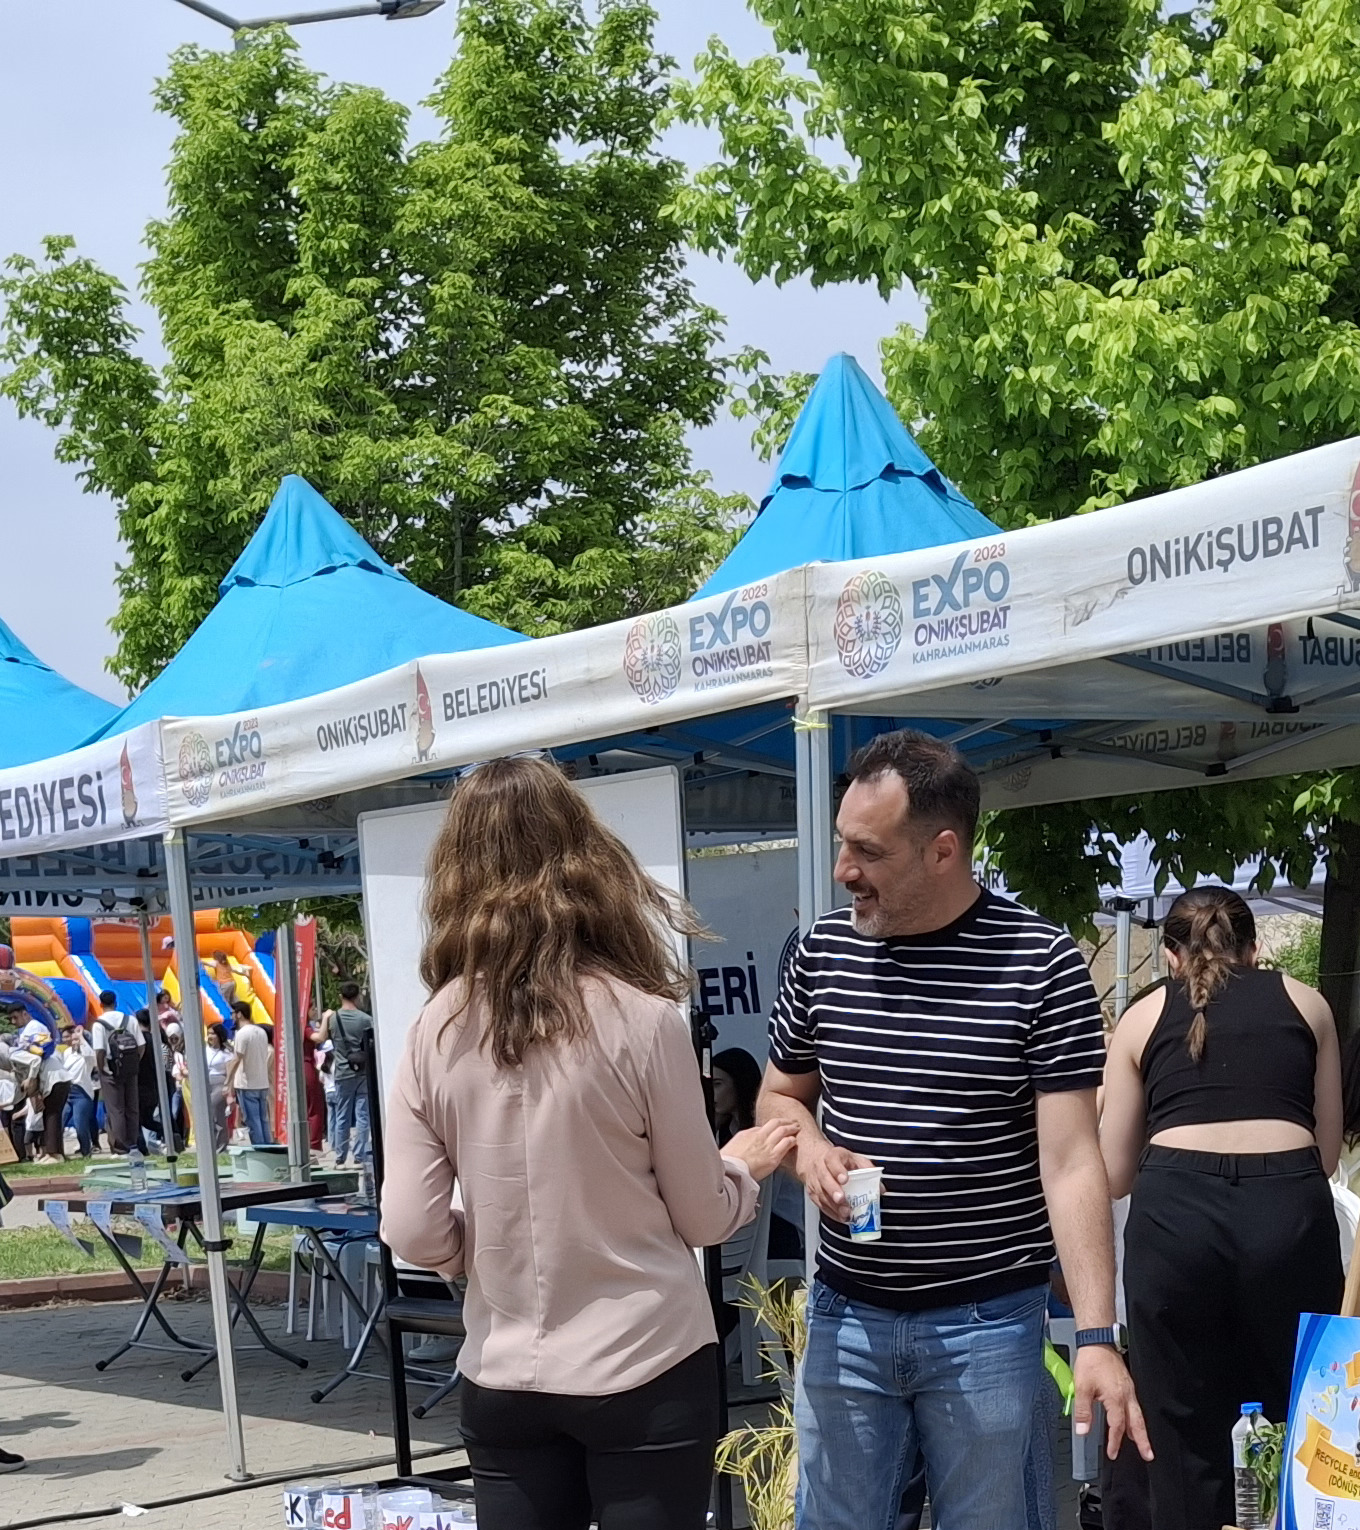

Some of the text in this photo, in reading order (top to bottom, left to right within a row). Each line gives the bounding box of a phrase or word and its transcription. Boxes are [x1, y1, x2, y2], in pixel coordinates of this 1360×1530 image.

[974, 542, 1006, 563] 2023
[1126, 505, 1326, 586] ONİKİŞUBAT
[742, 583, 768, 602] 2023
[912, 549, 1010, 619] EXPO
[689, 590, 771, 652] EXPO
[912, 634, 1010, 665] KAHRAMANMARAŞ
[317, 668, 549, 752] ONİKİŞUBAT BELEDİYESİ
[215, 721, 262, 768] EXPO
[696, 951, 762, 1017] ERİ
[1315, 1447, 1347, 1475] RECYCLE
